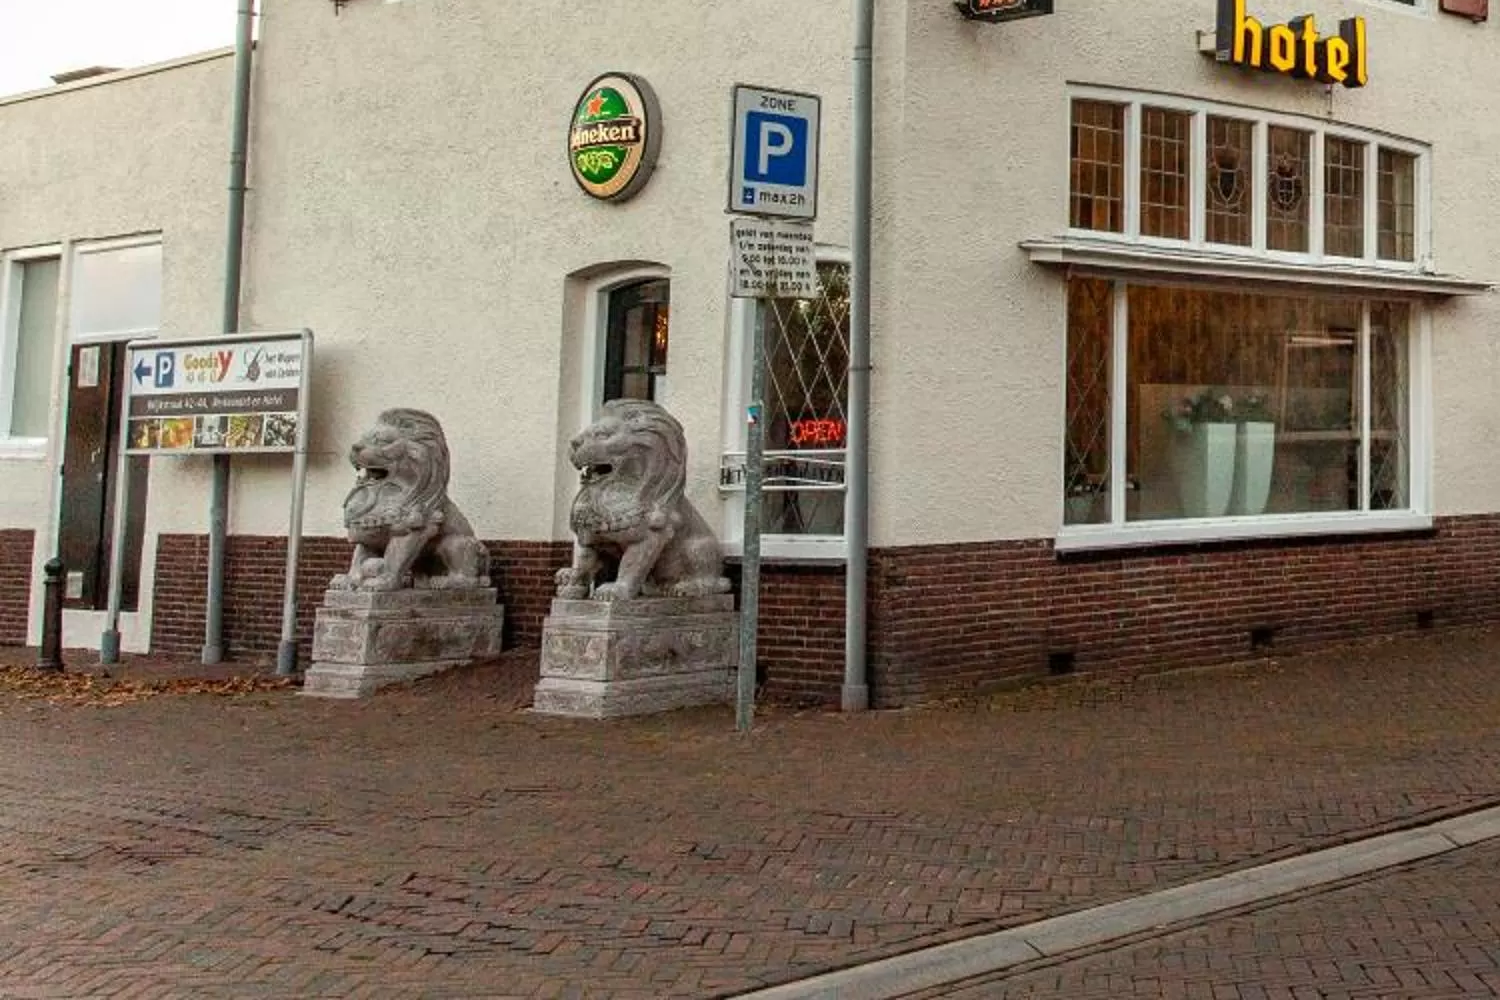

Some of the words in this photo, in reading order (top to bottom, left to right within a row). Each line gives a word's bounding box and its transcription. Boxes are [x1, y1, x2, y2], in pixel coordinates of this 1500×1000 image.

[760, 95, 796, 111] ZONE
[758, 121, 793, 175] P
[184, 351, 233, 383] Gooday
[791, 420, 842, 443] OPEN
